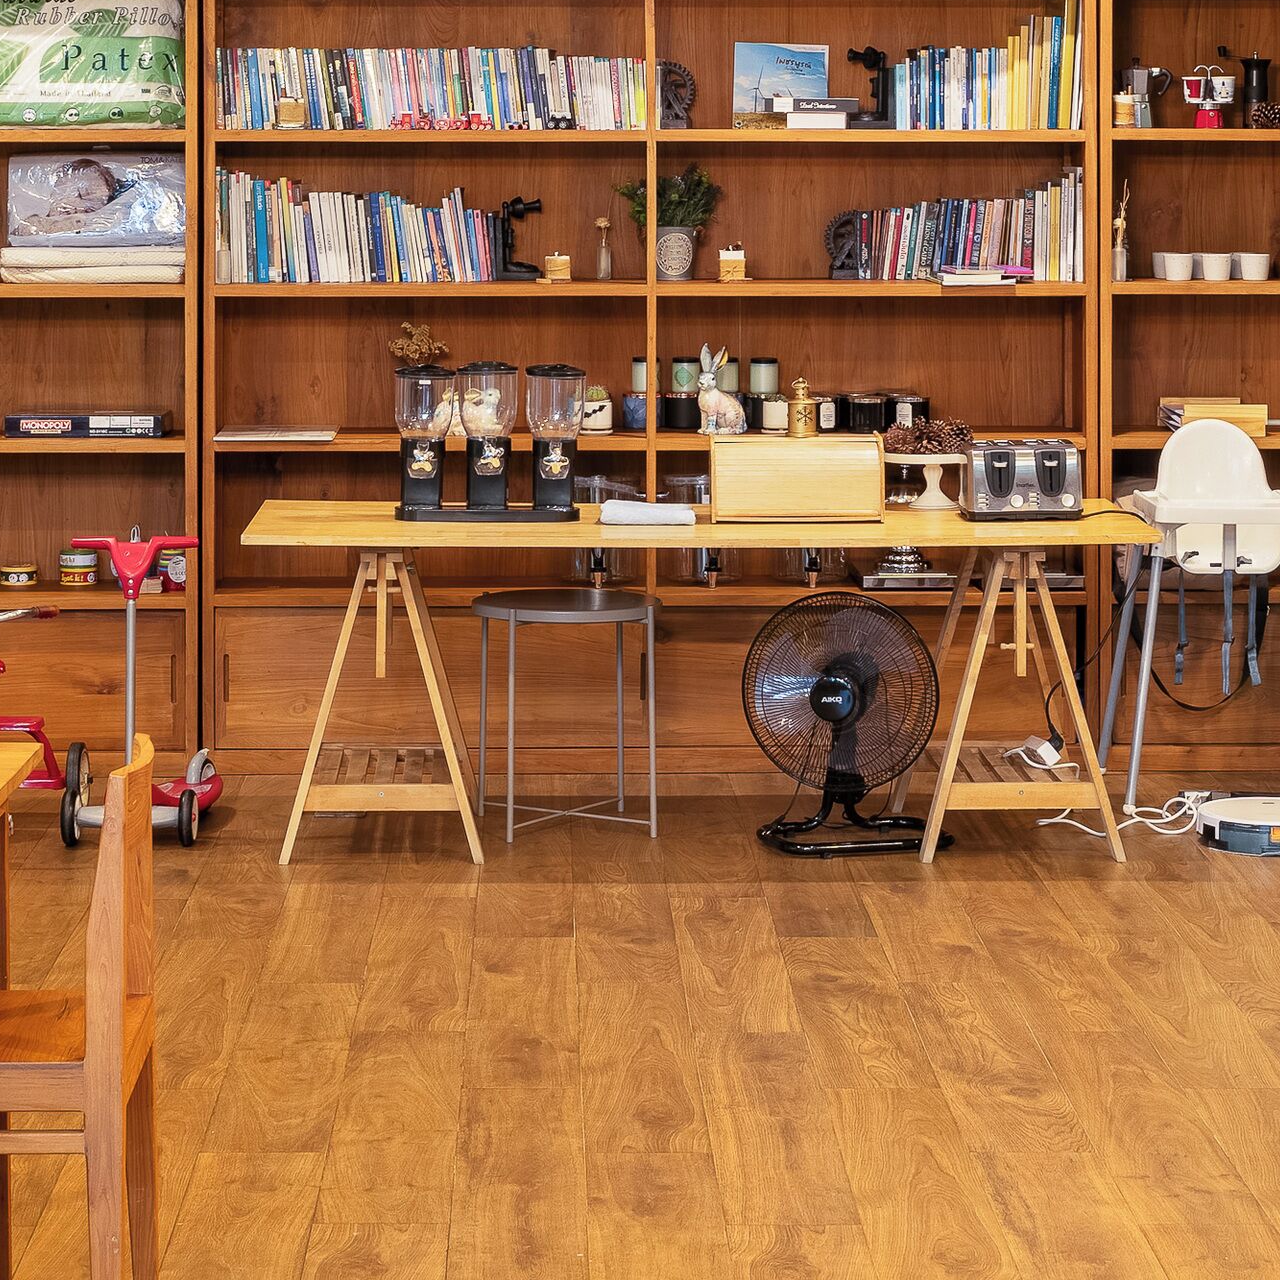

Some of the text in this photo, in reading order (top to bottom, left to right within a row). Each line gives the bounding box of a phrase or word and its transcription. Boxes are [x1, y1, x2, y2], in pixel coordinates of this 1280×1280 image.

[14, 6, 103, 26] Rubber
[61, 44, 178, 72] Patex
[919, 246, 929, 266] CAIRO
[22, 421, 70, 430] MONOPOLY
